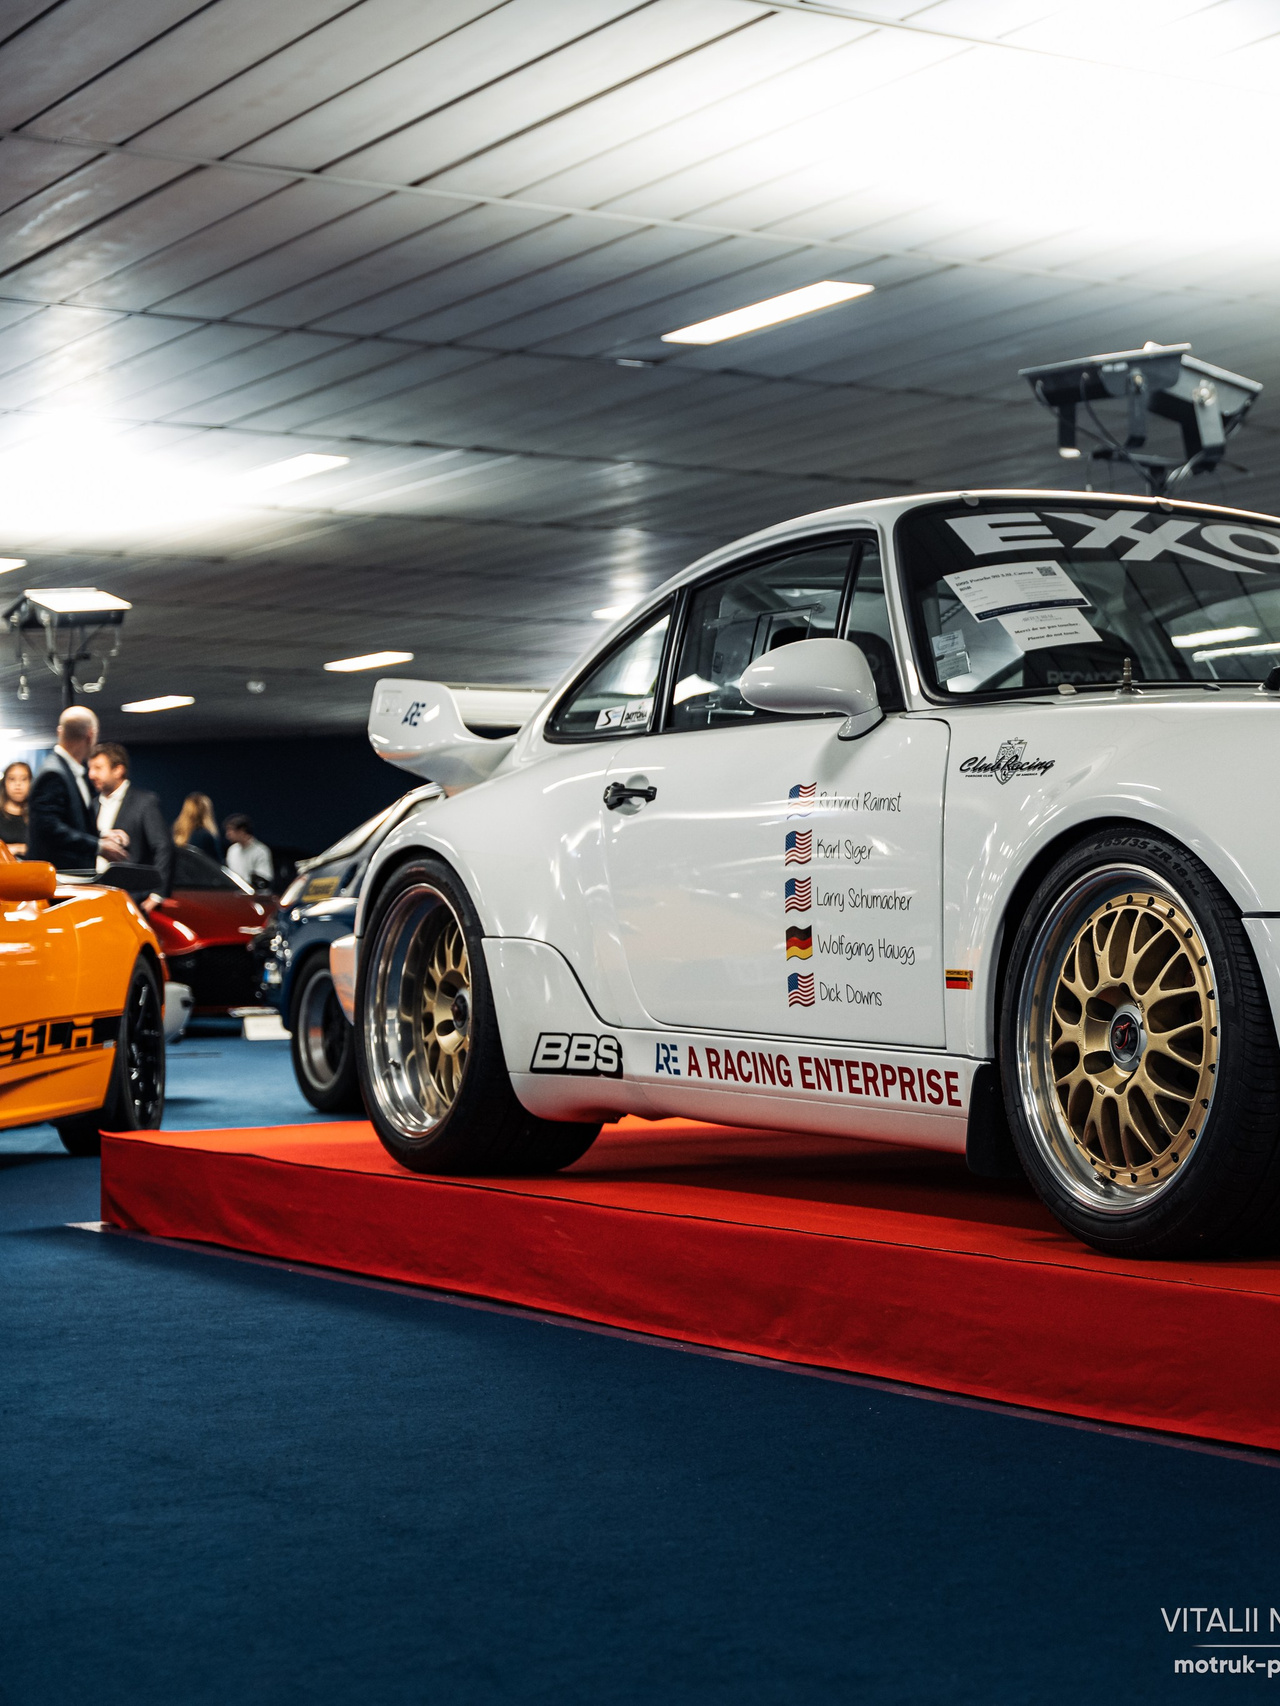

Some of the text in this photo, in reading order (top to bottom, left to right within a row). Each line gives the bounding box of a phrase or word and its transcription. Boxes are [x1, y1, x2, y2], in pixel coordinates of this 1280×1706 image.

[959, 754, 1056, 777] Club Racing
[863, 791, 902, 812] Raimist
[816, 839, 874, 864] Karl Siger
[816, 886, 912, 912] Larry Schumacher
[817, 934, 916, 965] Wolfgang Haugg
[819, 981, 883, 1007] Dick Downs
[529, 1032, 624, 1079] BBS
[687, 1046, 703, 1078] A
[705, 1047, 793, 1088] RACING
[797, 1055, 962, 1107] ENTERPRISE
